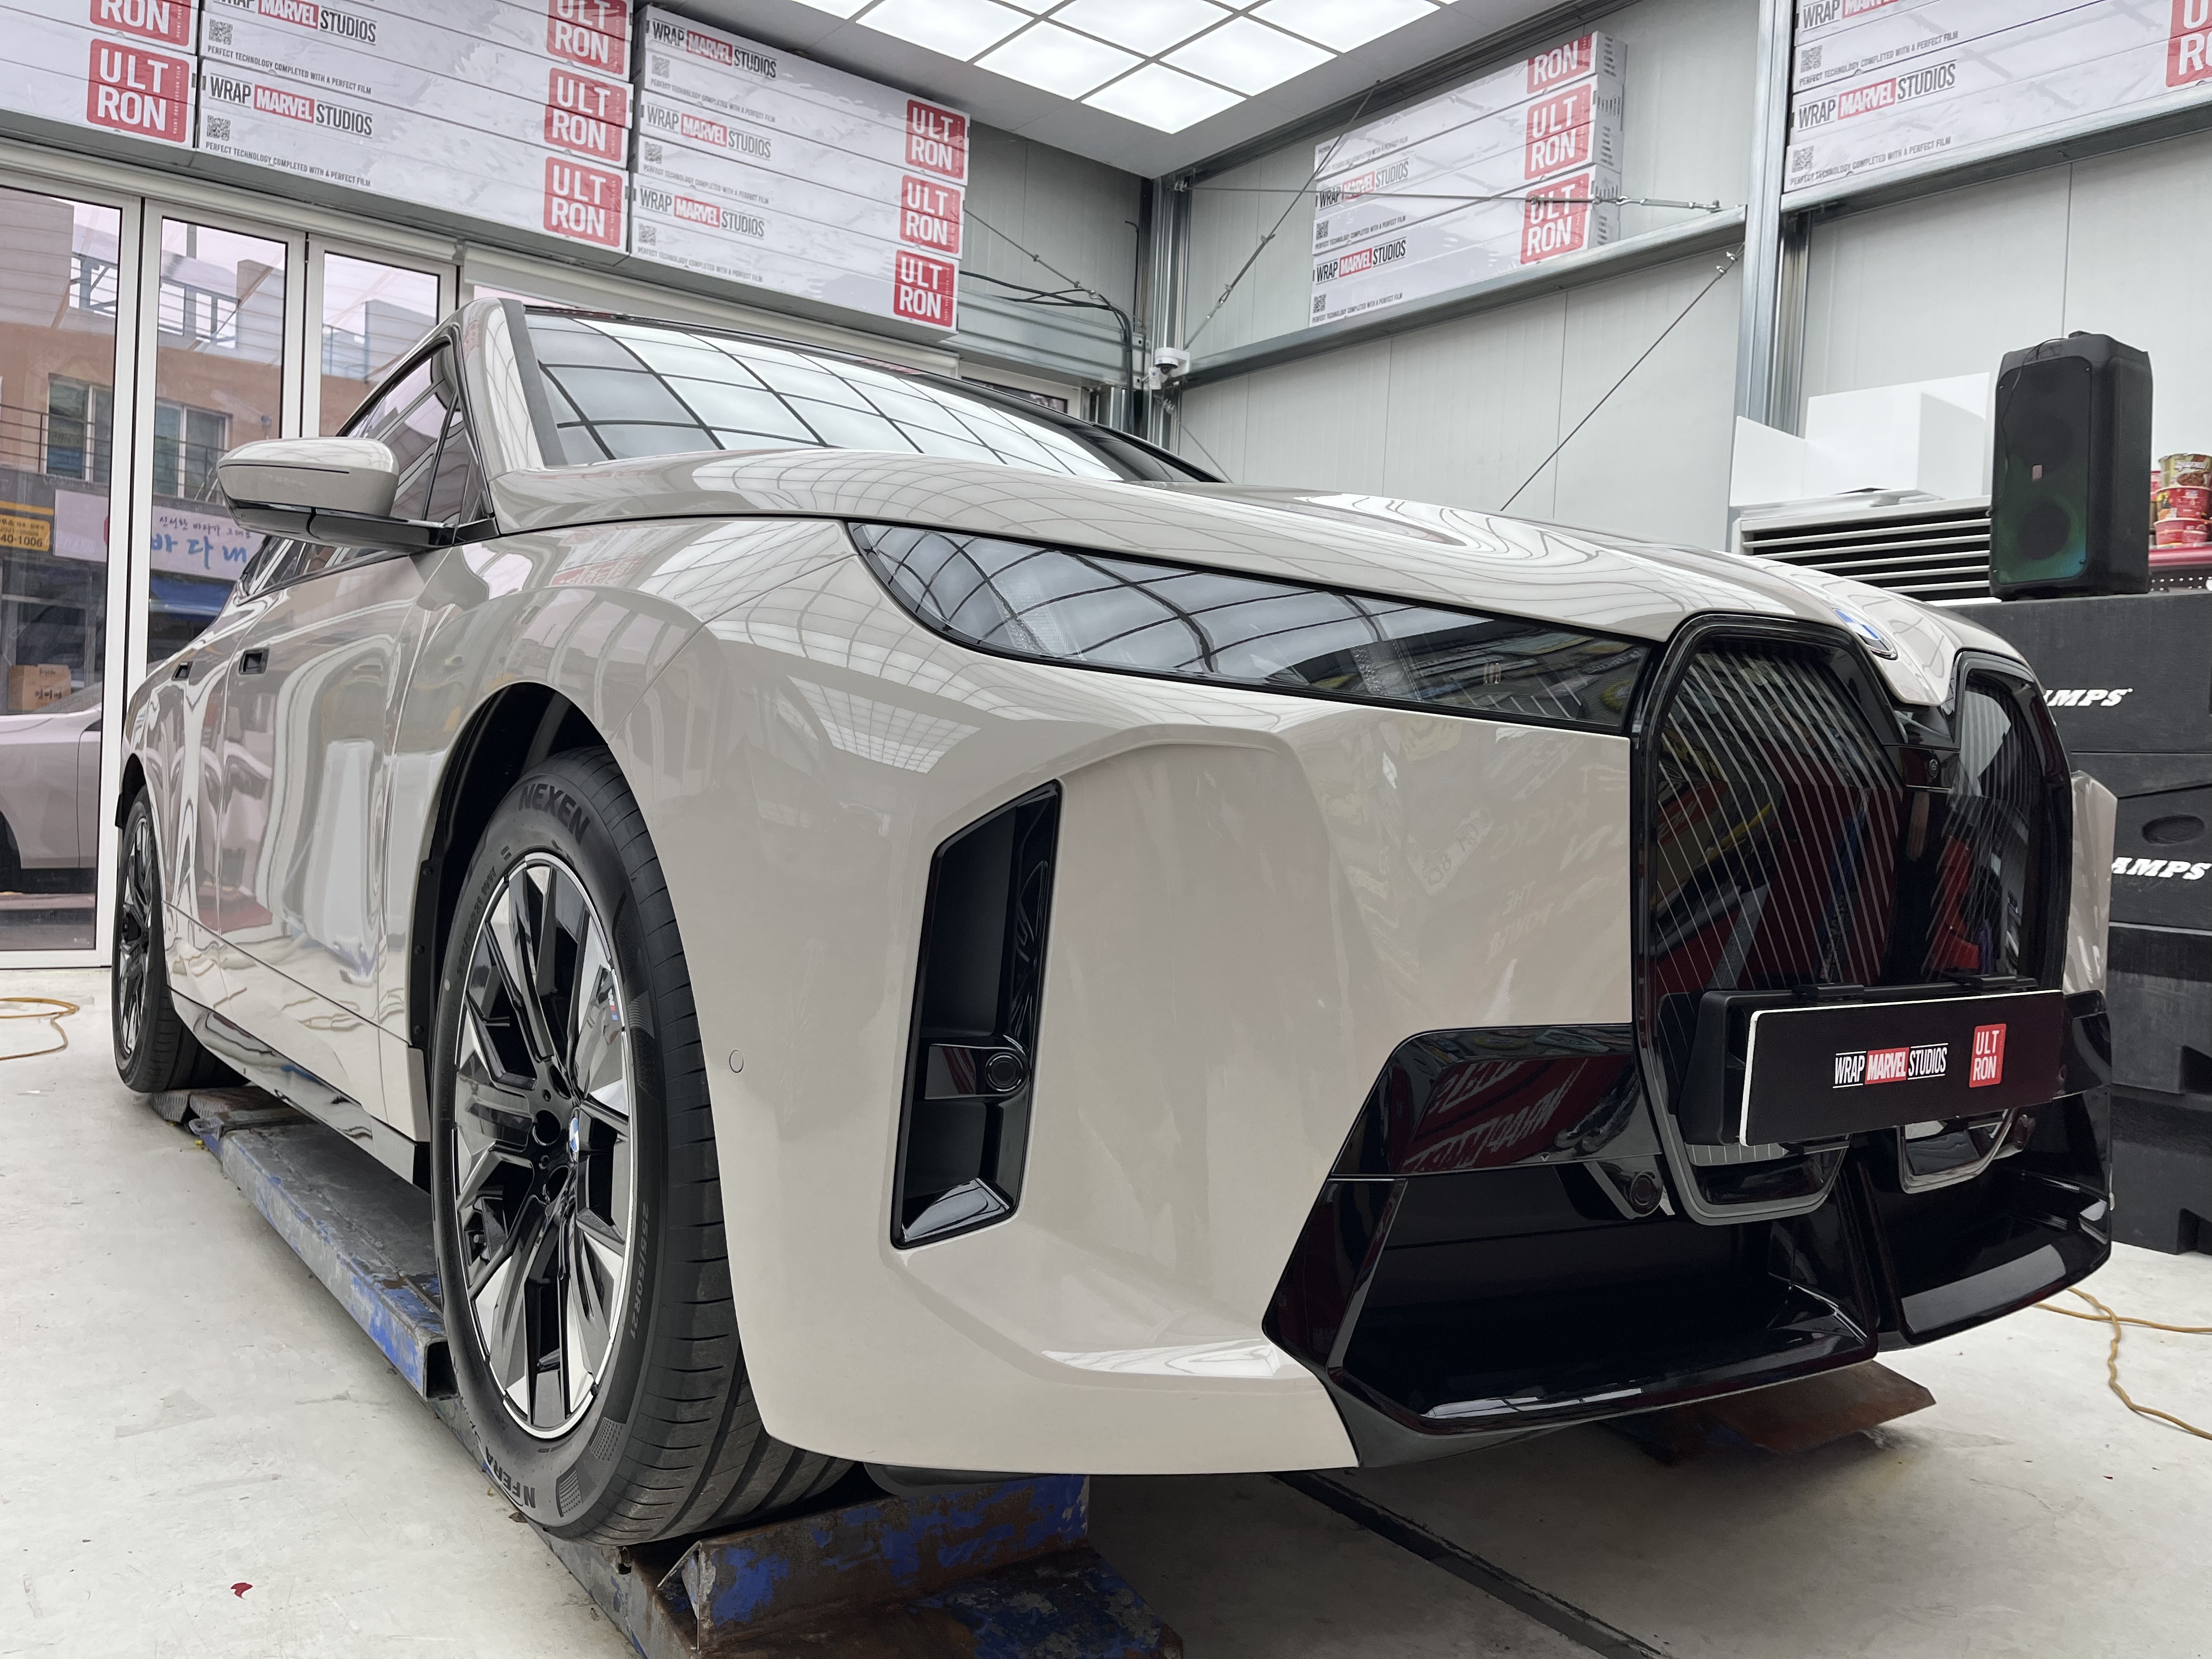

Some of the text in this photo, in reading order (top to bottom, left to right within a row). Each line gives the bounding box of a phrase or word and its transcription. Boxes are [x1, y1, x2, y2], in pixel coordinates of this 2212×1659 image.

[101, 0, 170, 35] RON
[261, 0, 376, 43] MARVEL STUDIOS
[557, 0, 610, 29] ULT
[1803, 0, 1840, 28] WRAP
[555, 20, 609, 63] RON
[653, 21, 684, 46] WRAP
[689, 33, 731, 63] MARVEL
[734, 49, 777, 78] STUDIOS
[100, 48, 169, 93] ULT
[208, 46, 233, 58] PERFECT
[236, 53, 273, 68] TECHNOLOGY
[275, 63, 308, 78] COMPLETED
[311, 72, 325, 82] WITH
[332, 78, 356, 90] PERFECT
[358, 84, 371, 94] FILM
[1533, 40, 1578, 86] RON
[98, 84, 166, 131] RON
[211, 76, 373, 136] WRAP MARVEL STUDIOS
[557, 76, 611, 117] ULT
[1533, 95, 1577, 138] ULT
[1799, 63, 1956, 128] WRAP MARVEL STUDIOS
[552, 109, 606, 151] RON
[647, 105, 679, 129] WRAP
[683, 116, 726, 145] MARVEL
[729, 130, 771, 158] STUDIOS
[913, 107, 953, 142] ULT
[206, 142, 231, 154] PERFECT
[234, 148, 270, 163] TECHNOLOGY
[273, 157, 307, 172] COMPLETED
[309, 166, 324, 176] WITH
[331, 171, 355, 183] PERFECT
[357, 178, 371, 187] FILM
[911, 135, 952, 171] RON
[1531, 128, 1577, 172] RON
[553, 165, 606, 204] ULT
[907, 182, 948, 216] ULT
[1320, 186, 1341, 207] WRAP
[1376, 160, 1409, 188] STUDIOS
[1531, 184, 1576, 224] ULT
[551, 197, 605, 237] RON
[640, 188, 672, 212] WRAP
[676, 199, 719, 225] MARVEL
[722, 211, 765, 237] STUDIOS
[906, 210, 947, 245] RON
[1527, 216, 1572, 256] RON
[901, 257, 943, 290] ULT
[1317, 239, 1406, 282] WRAP MARVEL STUDIOS
[900, 285, 941, 319] RON
[518, 783, 590, 845] NEXEN
[1976, 1030, 1999, 1055] ULT
[1835, 1047, 1948, 1084] WRAP MARVEL STUDIOS
[1973, 1056, 1997, 1081] RON
[631, 1201, 649, 1340] 255/50R21
